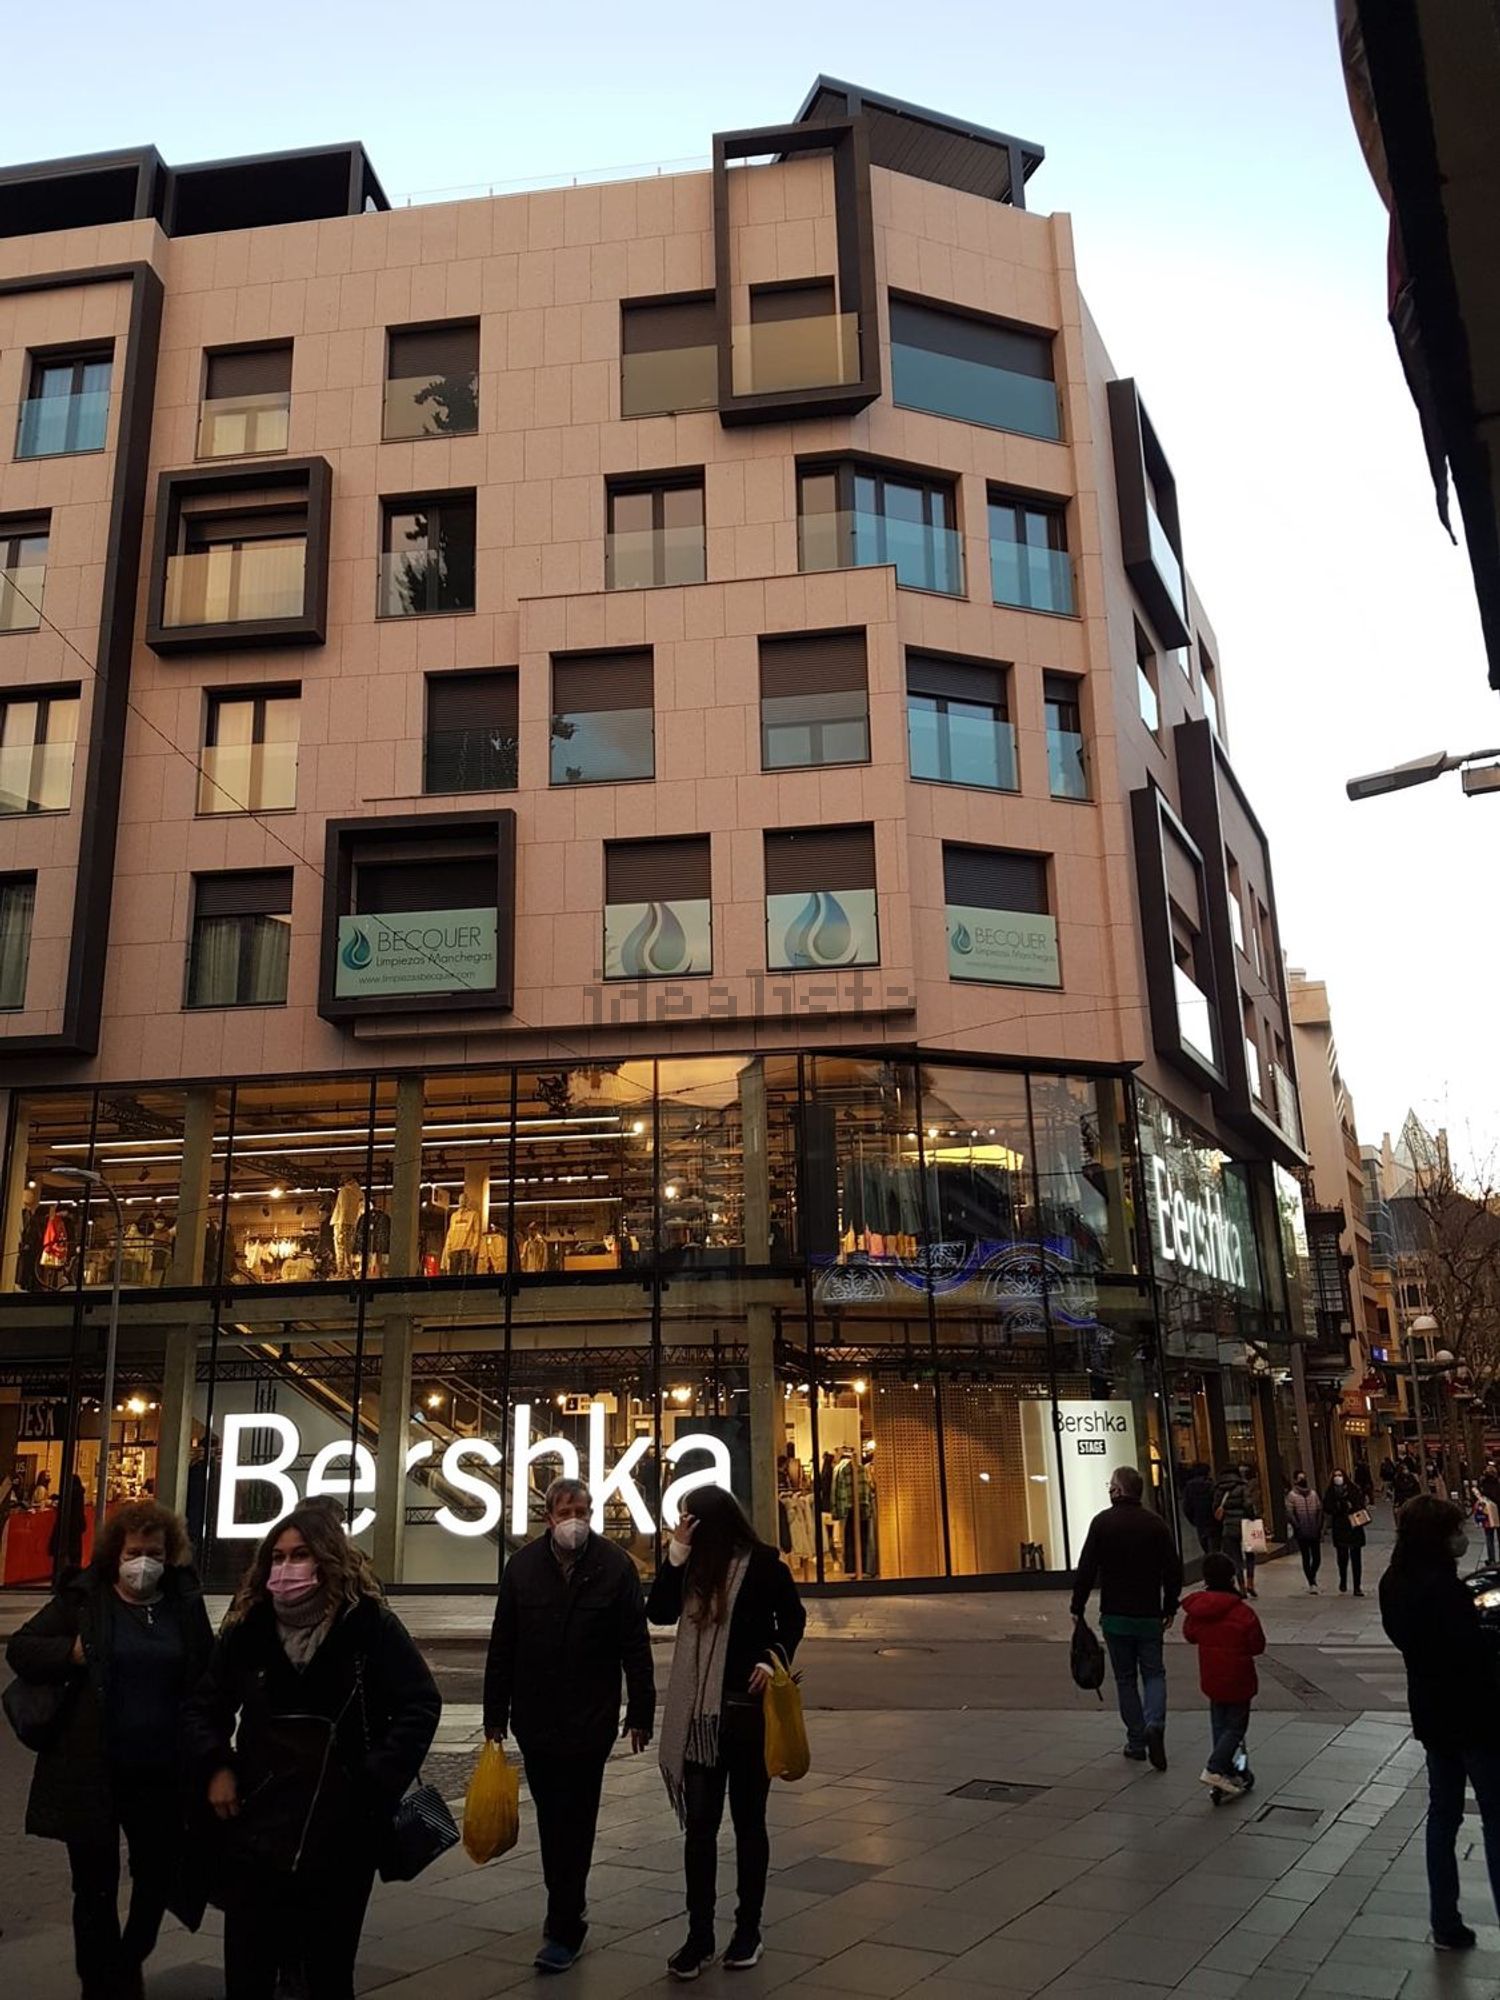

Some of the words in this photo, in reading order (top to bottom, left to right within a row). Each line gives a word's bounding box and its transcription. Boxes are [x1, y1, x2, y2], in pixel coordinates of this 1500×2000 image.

[378, 926, 482, 952] BECQUER
[975, 927, 1047, 950] BECQUER
[376, 955, 426, 970] Limpiezas
[428, 950, 493, 967] Manchegas
[1152, 1154, 1246, 1288] Bershka
[1053, 1410, 1127, 1433] Bershka
[1079, 1441, 1105, 1453] STAGE
